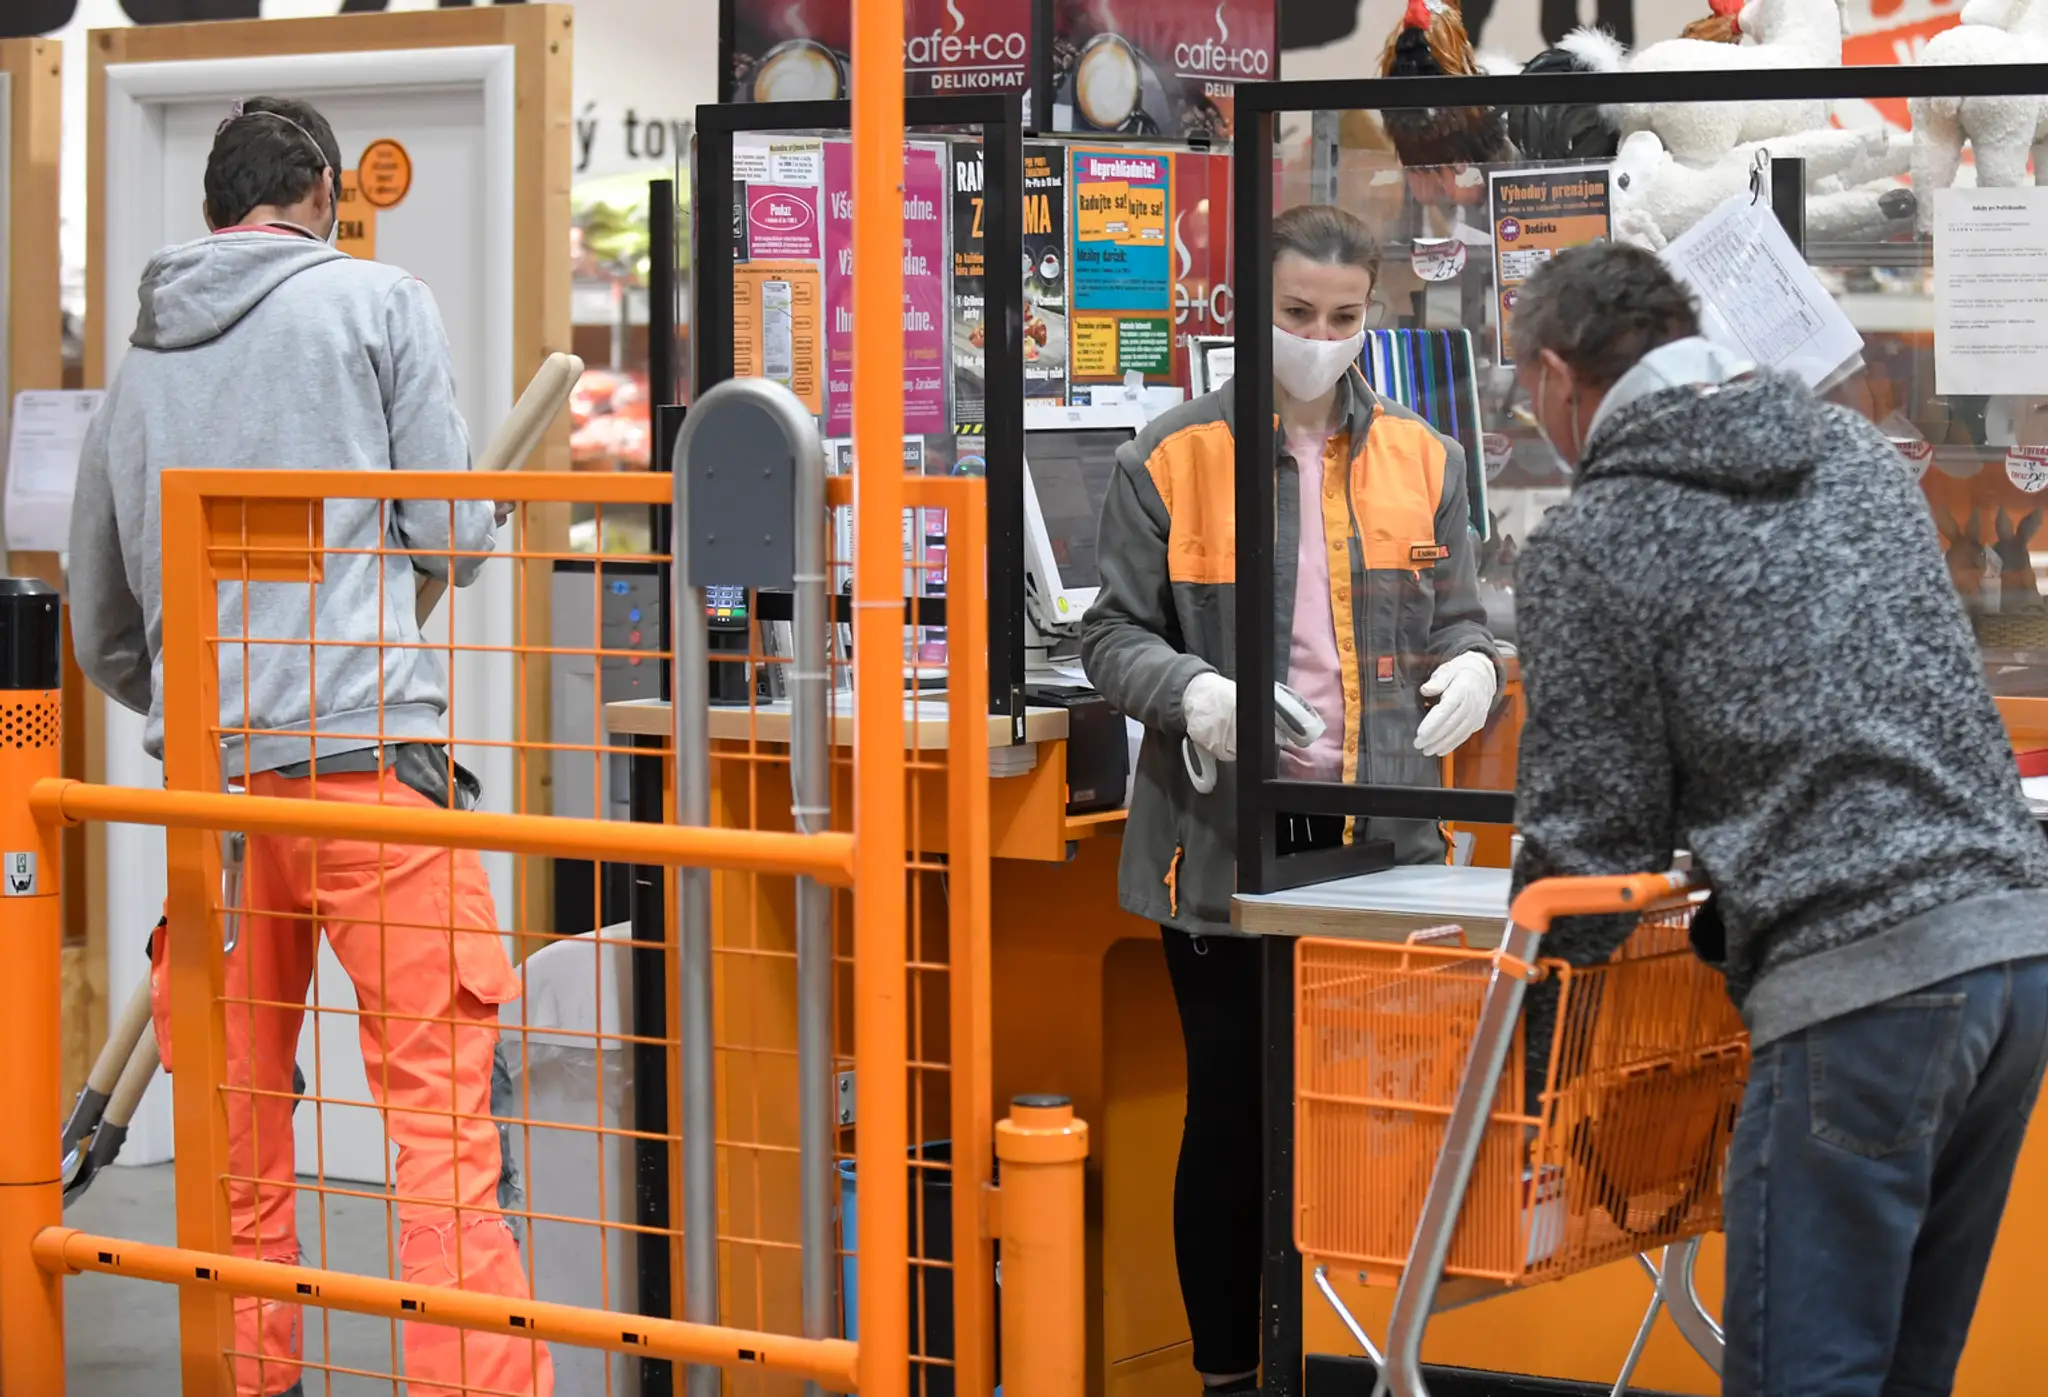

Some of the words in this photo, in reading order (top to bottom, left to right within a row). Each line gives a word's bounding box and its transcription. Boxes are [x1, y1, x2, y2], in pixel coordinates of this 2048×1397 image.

[901, 28, 1027, 63] afé+co
[930, 71, 1025, 90] DELIKOMAT
[1204, 82, 1235, 98] DELI
[956, 150, 984, 192] RAŇ
[1079, 193, 1112, 214] Radujte
[1114, 193, 1128, 210] sa!
[1500, 182, 1547, 203] Výhodný
[1552, 180, 1605, 202] prenájom
[903, 194, 937, 220] odne.
[1150, 200, 1163, 216] sa!
[903, 247, 931, 276] dne.
[902, 305, 935, 332] odne.
